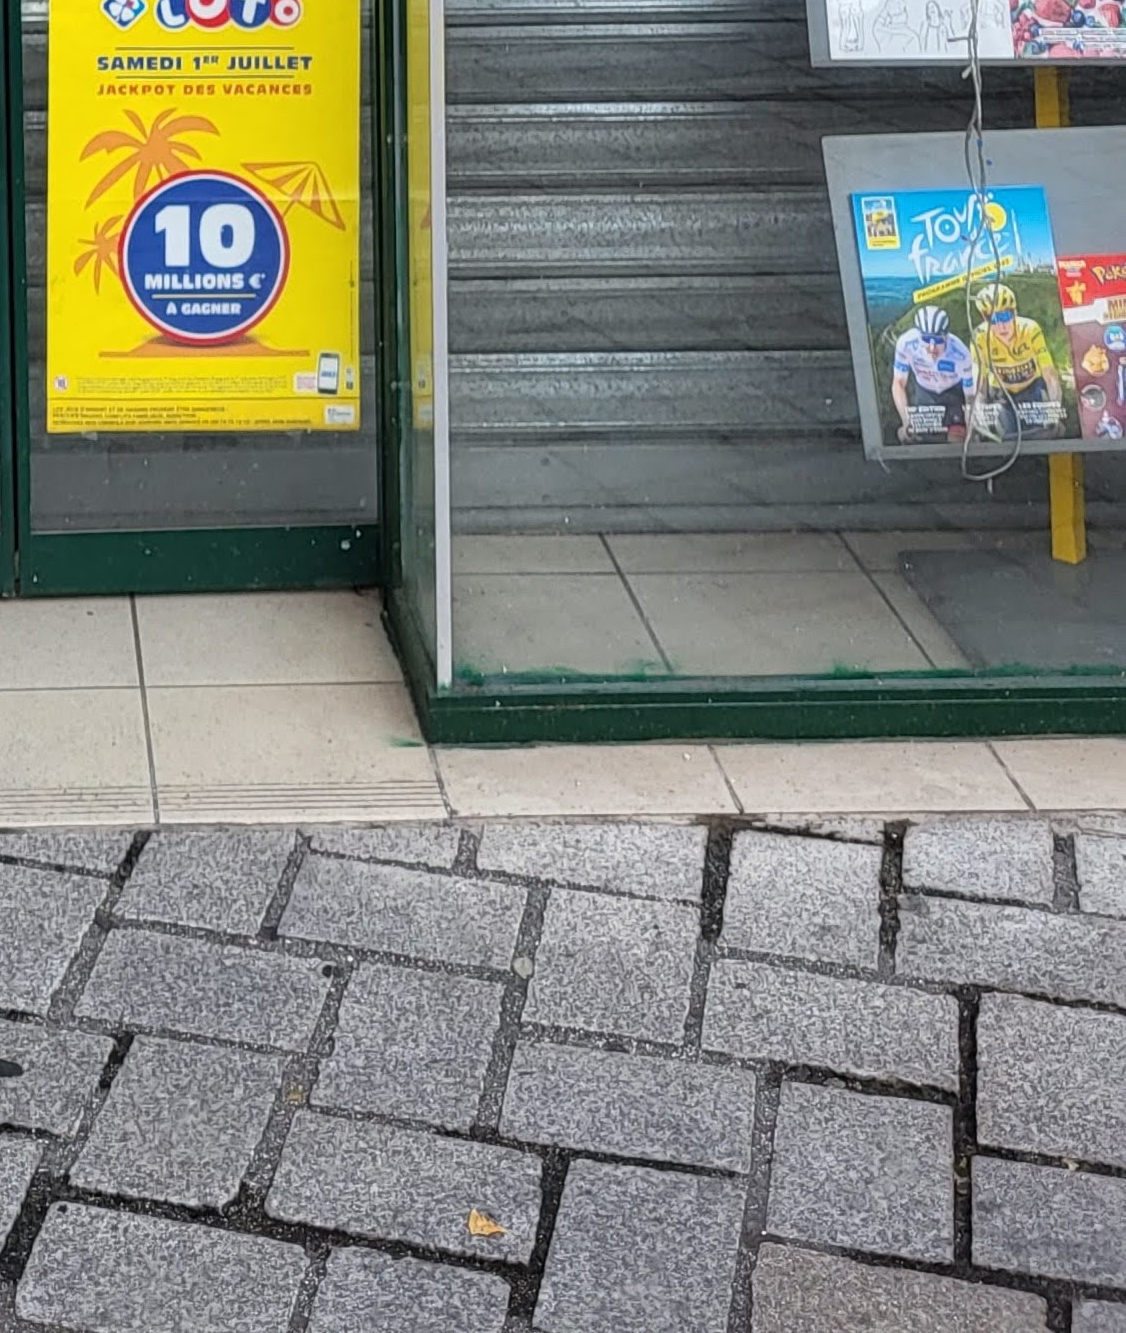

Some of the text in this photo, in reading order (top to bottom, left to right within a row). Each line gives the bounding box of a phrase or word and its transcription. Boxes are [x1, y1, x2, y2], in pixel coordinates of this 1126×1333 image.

[97, 55, 183, 72] SAMEDI
[227, 54, 314, 71] JUILLET
[97, 83, 314, 96] JACKPOT DES VACANCES
[154, 202, 257, 269] 10
[144, 272, 245, 291] MILLIONS
